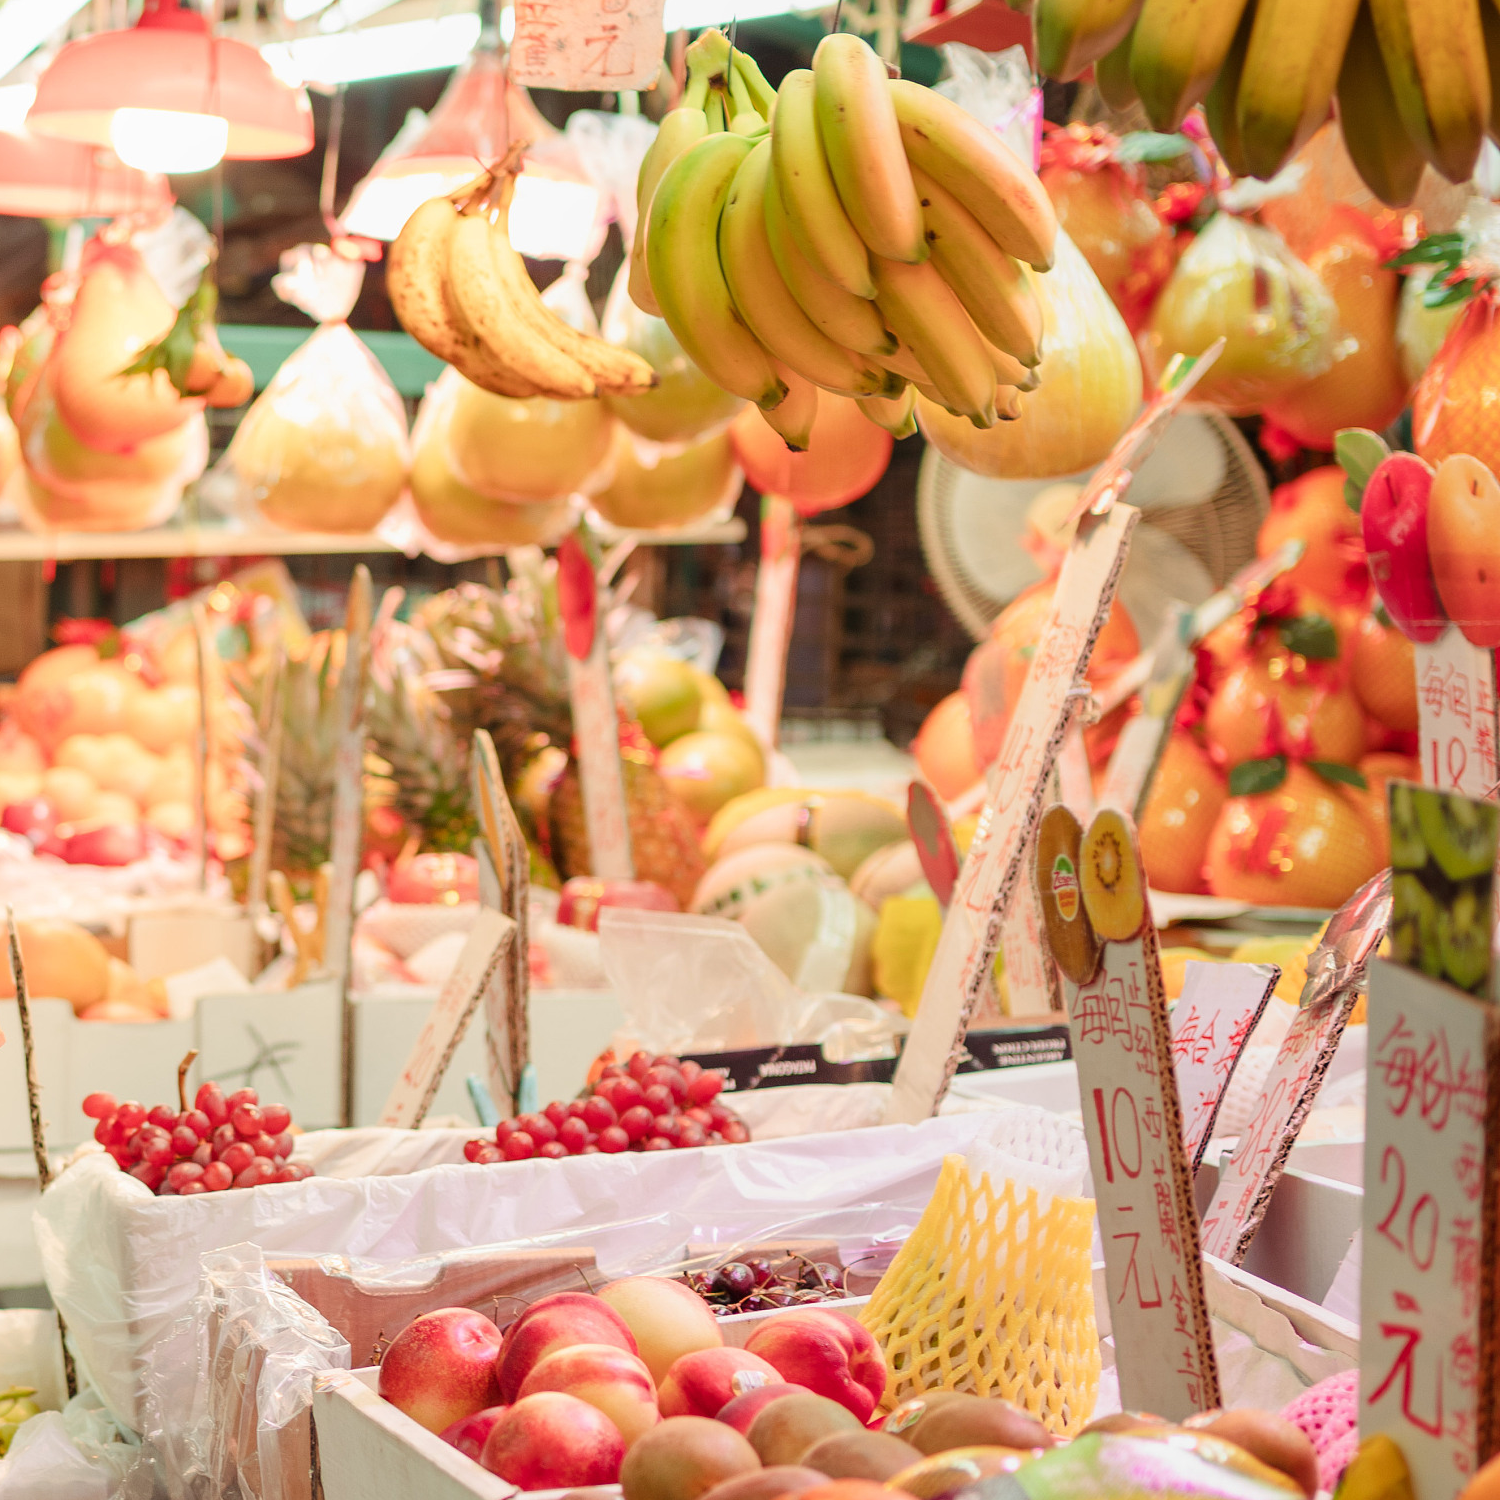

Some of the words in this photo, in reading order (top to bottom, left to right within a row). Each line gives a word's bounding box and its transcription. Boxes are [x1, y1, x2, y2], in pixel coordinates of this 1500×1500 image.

[581, 23, 636, 78] 元
[1092, 1087, 1143, 1184] 10
[1229, 1076, 1288, 1178] 38
[1112, 1205, 1163, 1310] 元
[1376, 1144, 1440, 1272] 20
[1366, 1289, 1444, 1440] 元
